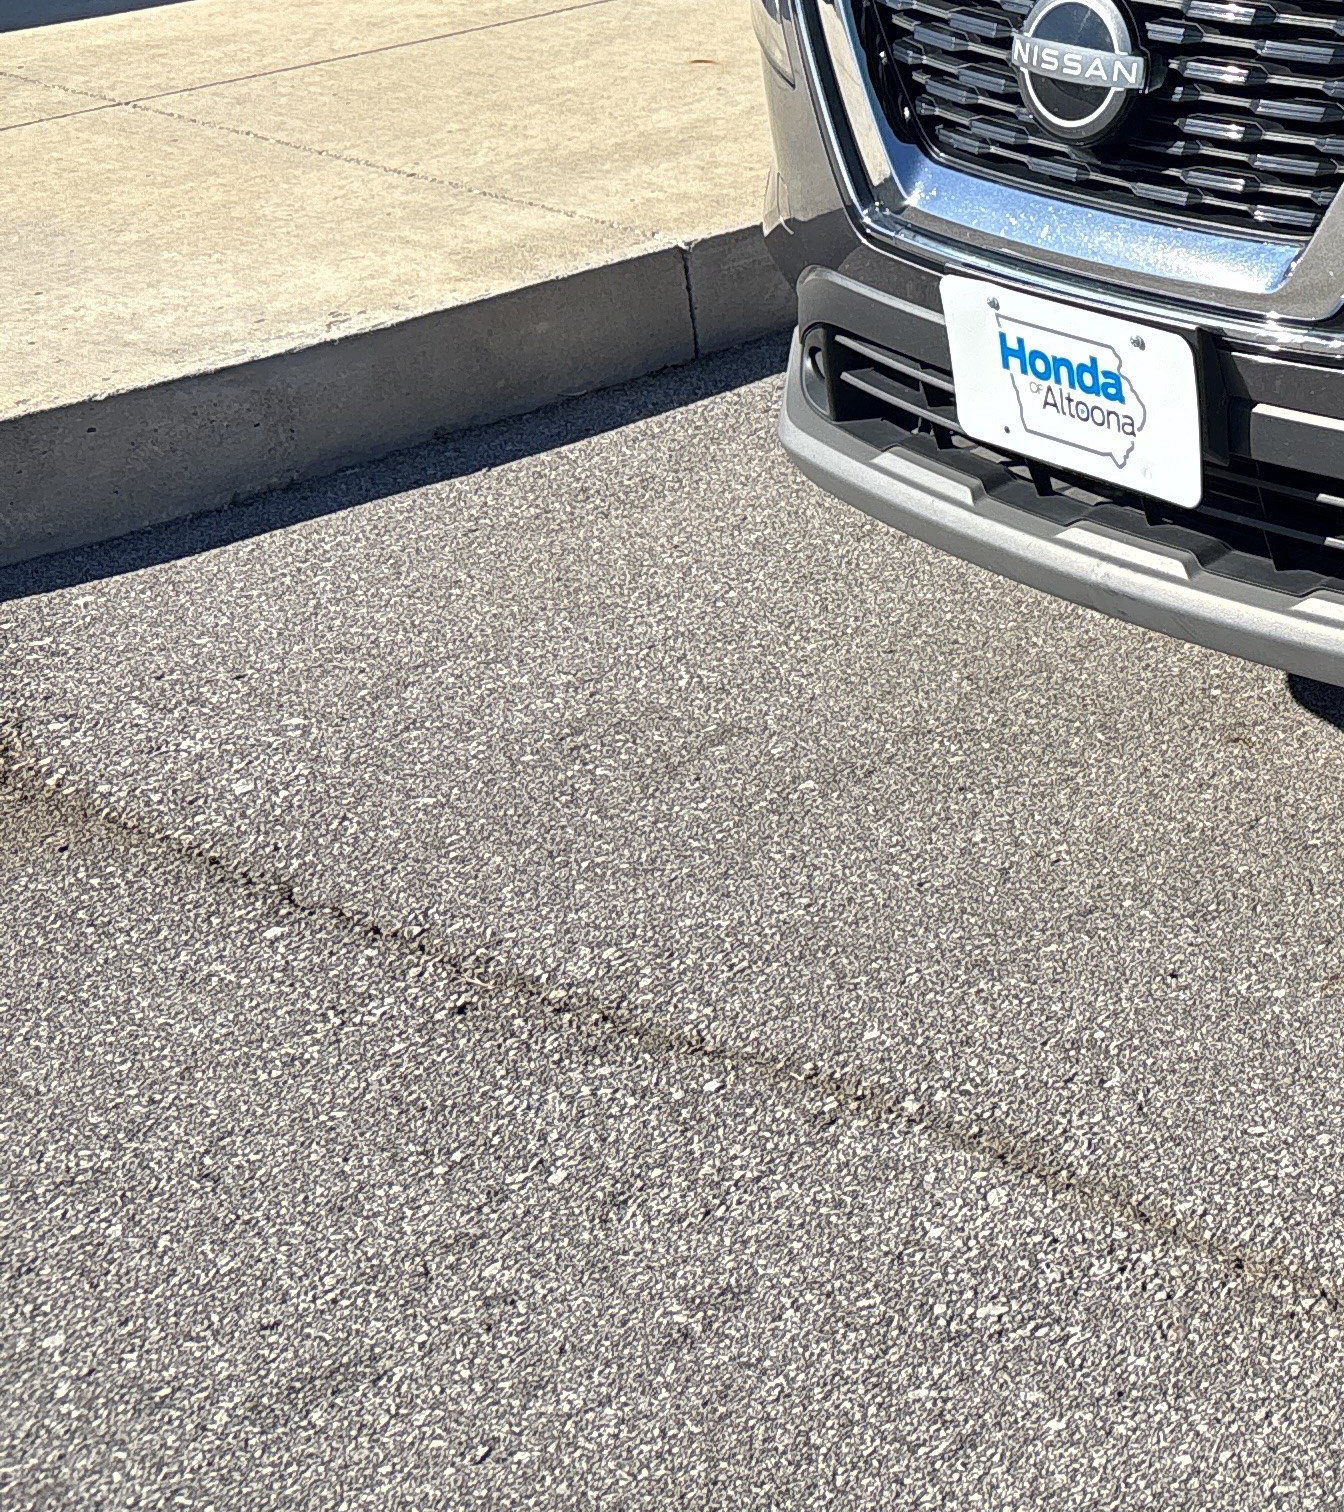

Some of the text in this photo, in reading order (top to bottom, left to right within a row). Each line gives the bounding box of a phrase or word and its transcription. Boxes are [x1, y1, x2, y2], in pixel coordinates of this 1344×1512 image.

[1013, 39, 1138, 84] NISSAN
[999, 330, 1125, 405] Honda
[1043, 385, 1136, 437] Altoona
